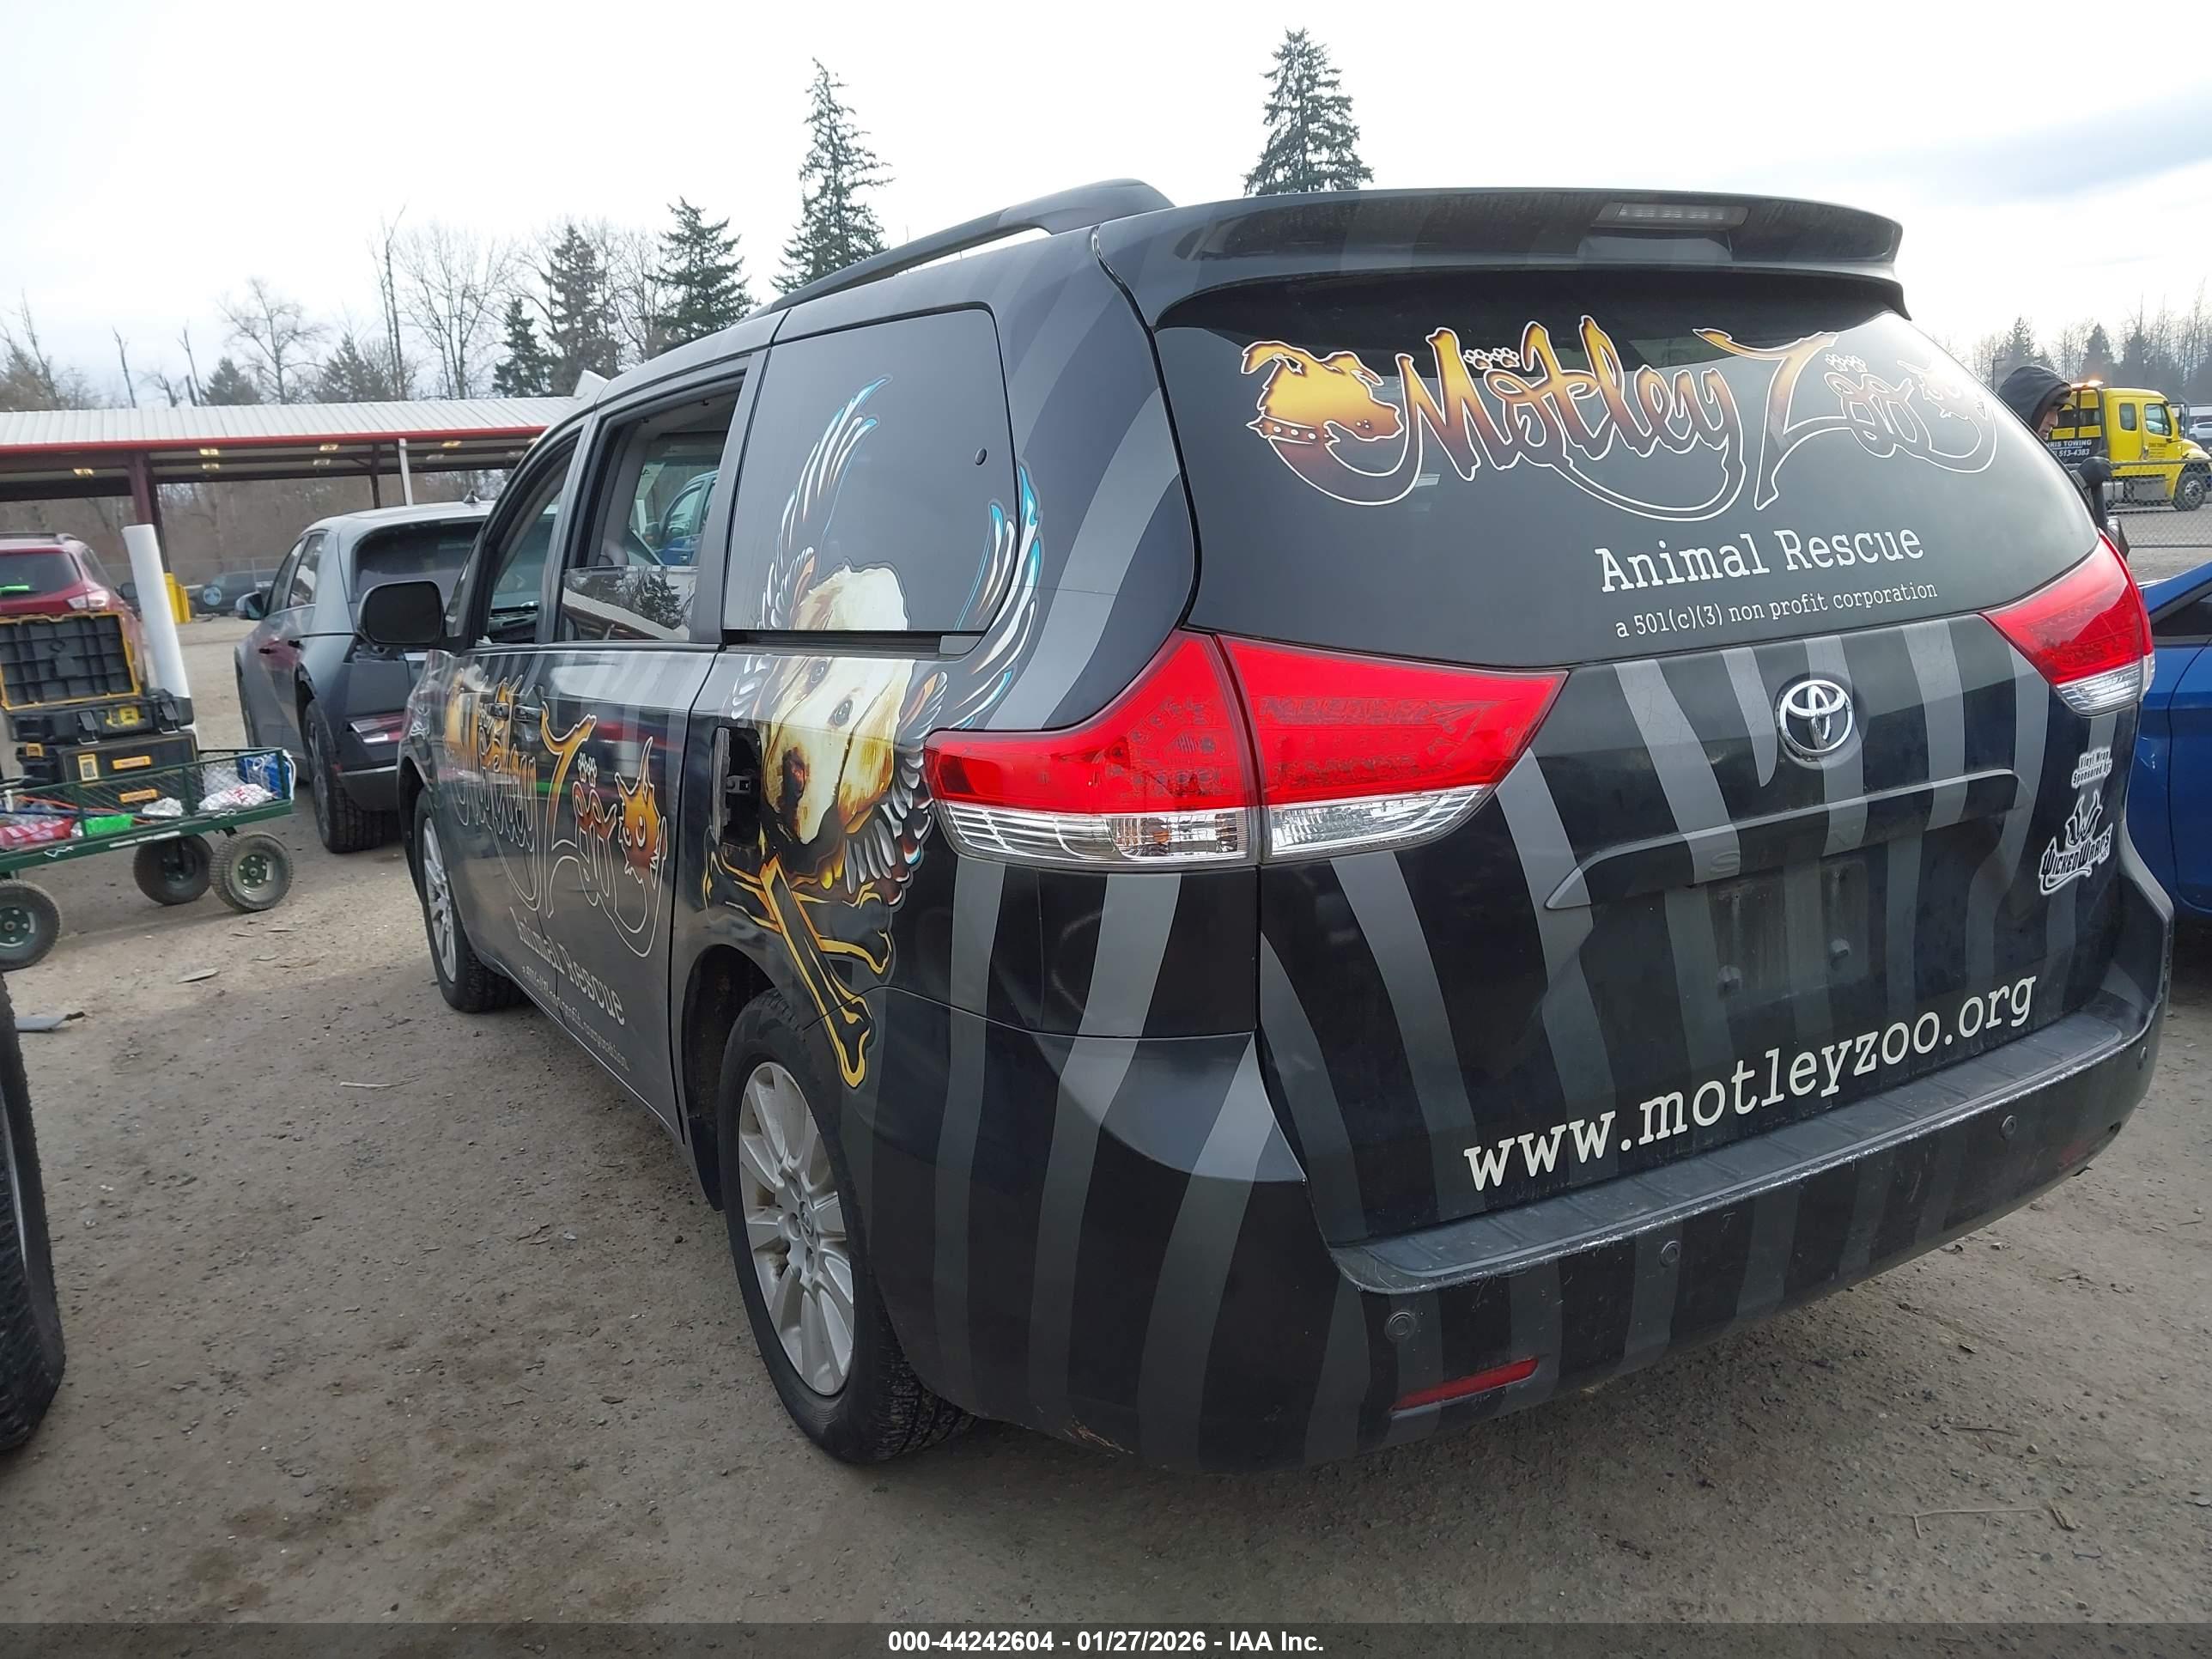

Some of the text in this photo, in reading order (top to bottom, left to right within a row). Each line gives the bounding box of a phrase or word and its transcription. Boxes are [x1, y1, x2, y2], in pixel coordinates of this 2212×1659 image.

[1594, 527, 1925, 592] Animal Rescue
[1615, 580, 1938, 637] a 501(c)(3) non profit corporation
[2073, 765, 2102, 785] Sponsored
[2080, 750, 2110, 769] Vinyl Wrap
[556, 942, 625, 1026] Rescue
[1462, 974, 2038, 1193] www.motleyzoo.org
